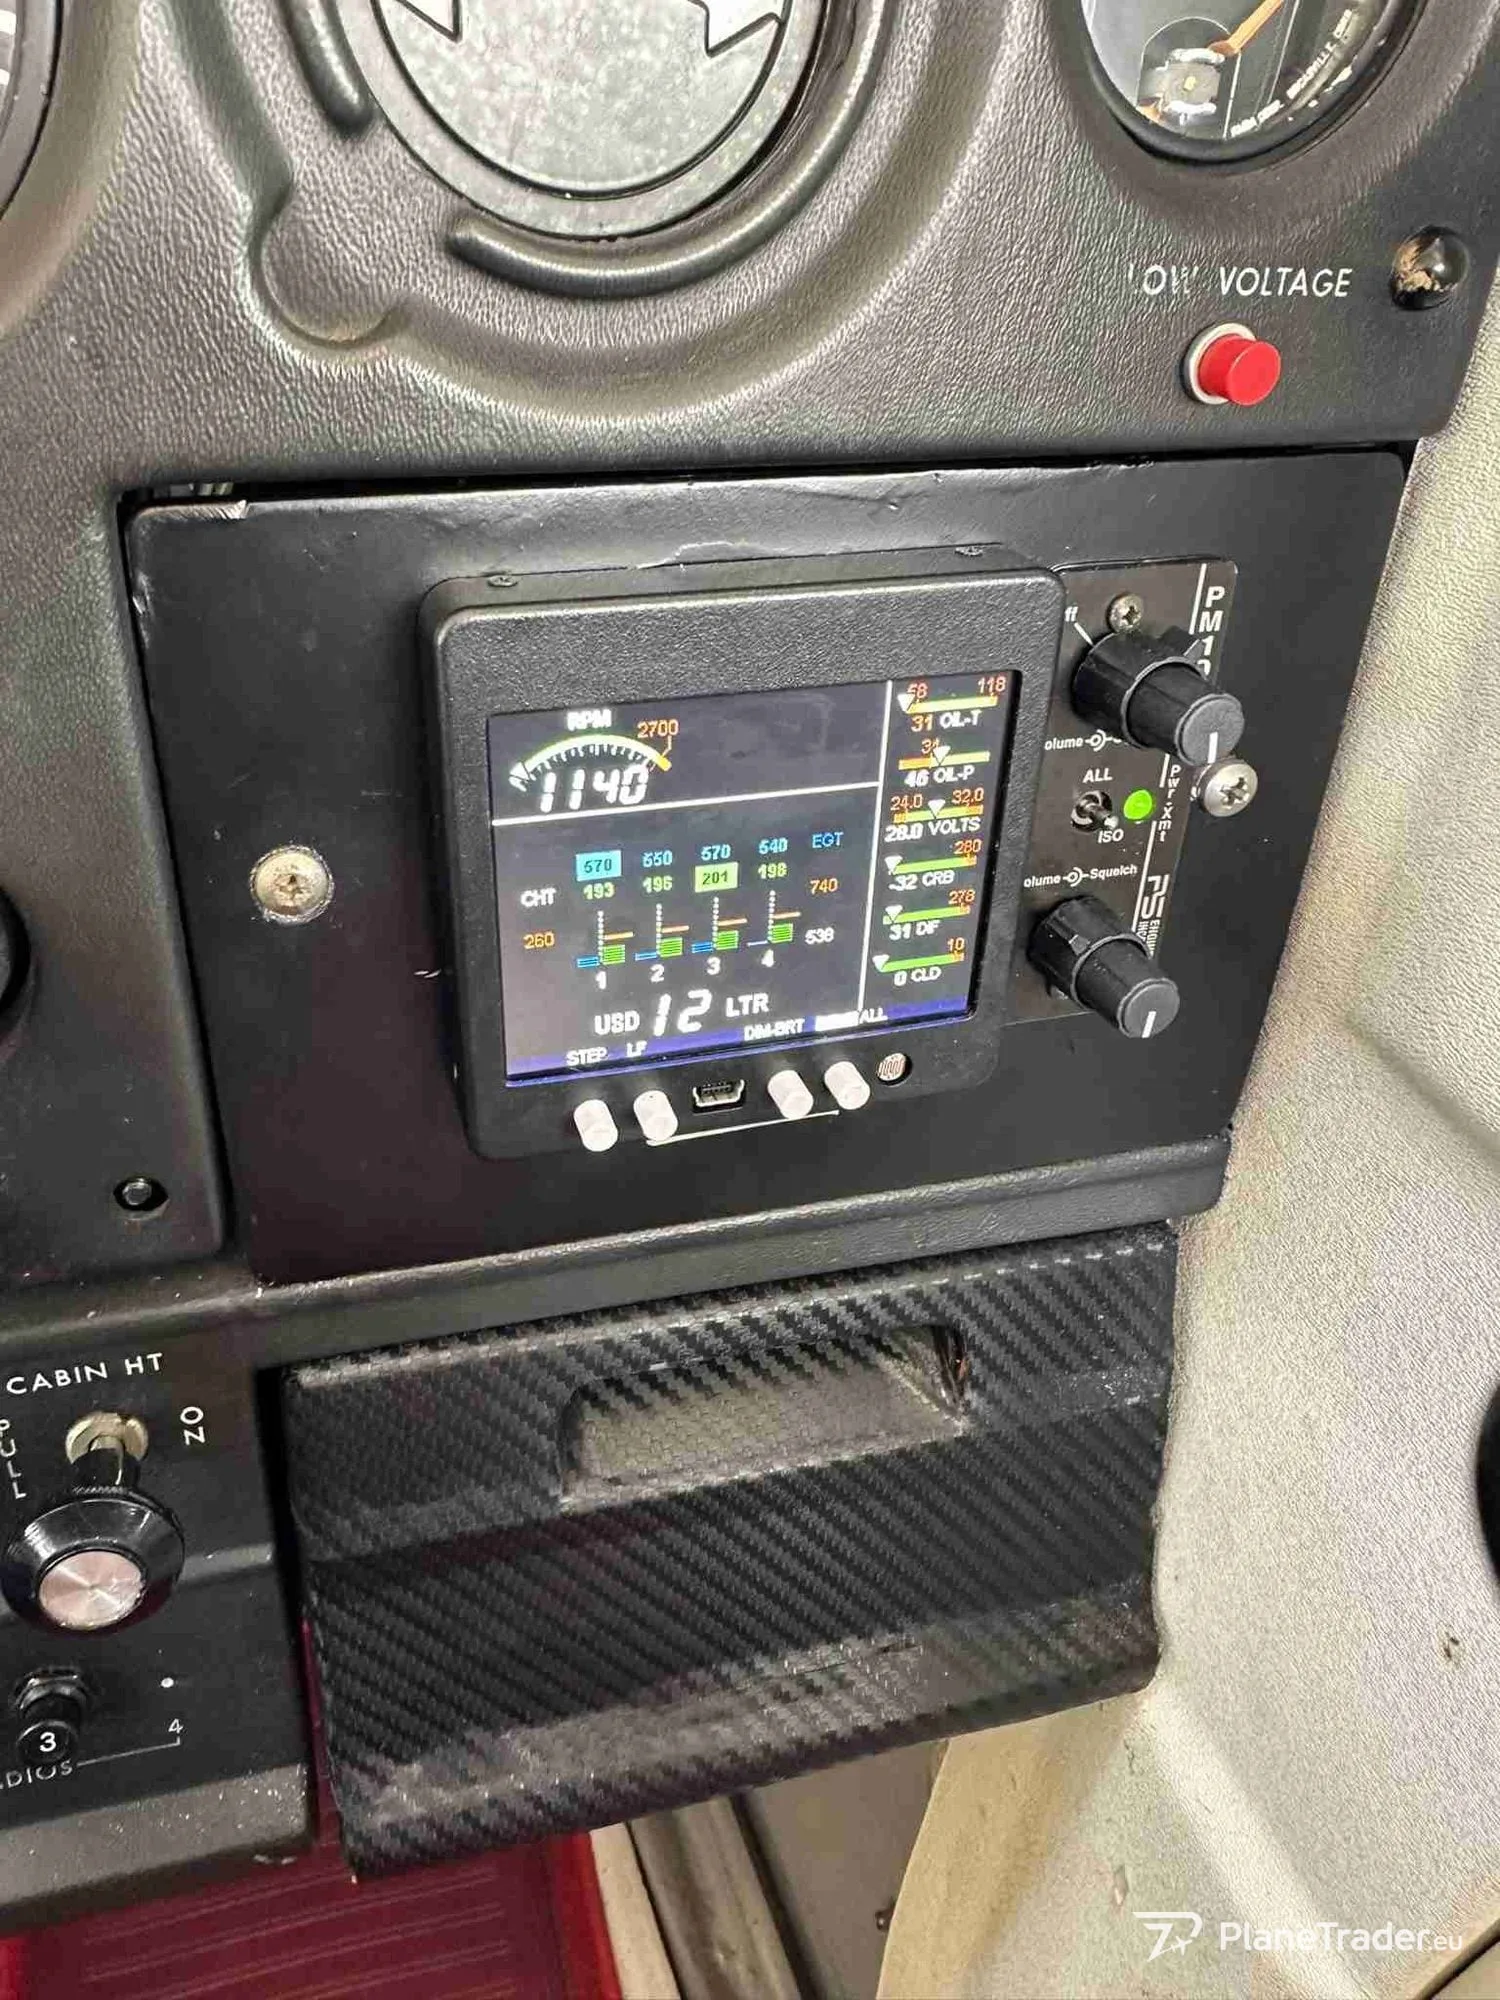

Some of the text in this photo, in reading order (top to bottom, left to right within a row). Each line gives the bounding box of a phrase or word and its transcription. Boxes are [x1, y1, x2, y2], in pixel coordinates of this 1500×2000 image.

[1219, 266, 1354, 298] VOLTAGE
[1064, 606, 1079, 622] ff
[977, 676, 1007, 694] 118
[566, 708, 613, 731] RPM
[636, 718, 680, 739] 2700
[911, 714, 934, 732] 31
[1044, 737, 1084, 751] olume
[1083, 768, 1113, 784] ALL
[539, 763, 650, 813] 1140
[890, 787, 985, 811] 24.0 32.0
[927, 816, 982, 836] VOLTS
[1098, 828, 1125, 844] ISO
[583, 858, 613, 874] 570
[700, 844, 732, 861] 570
[811, 831, 844, 849] EGT
[953, 838, 983, 855] 280
[921, 870, 956, 887] CRB
[1023, 863, 1139, 888] olume Squelch
[520, 887, 557, 907] CHT
[701, 870, 729, 886] 201
[809, 878, 839, 895] 740
[522, 931, 556, 949] 260
[946, 937, 965, 952] 10
[595, 949, 775, 990] 1 2 3 4
[893, 966, 942, 987] 0 CLD
[593, 988, 770, 1037] USD 12 LTR
[566, 1046, 609, 1066] STEP
[859, 1008, 888, 1023] ALL
[6, 1352, 164, 1395] CABIN HT
[180, 1405, 206, 1446] ON
[168, 1717, 184, 1735] 4
[39, 1731, 57, 1752] 3
[0, 1759, 73, 1789] DIOS
